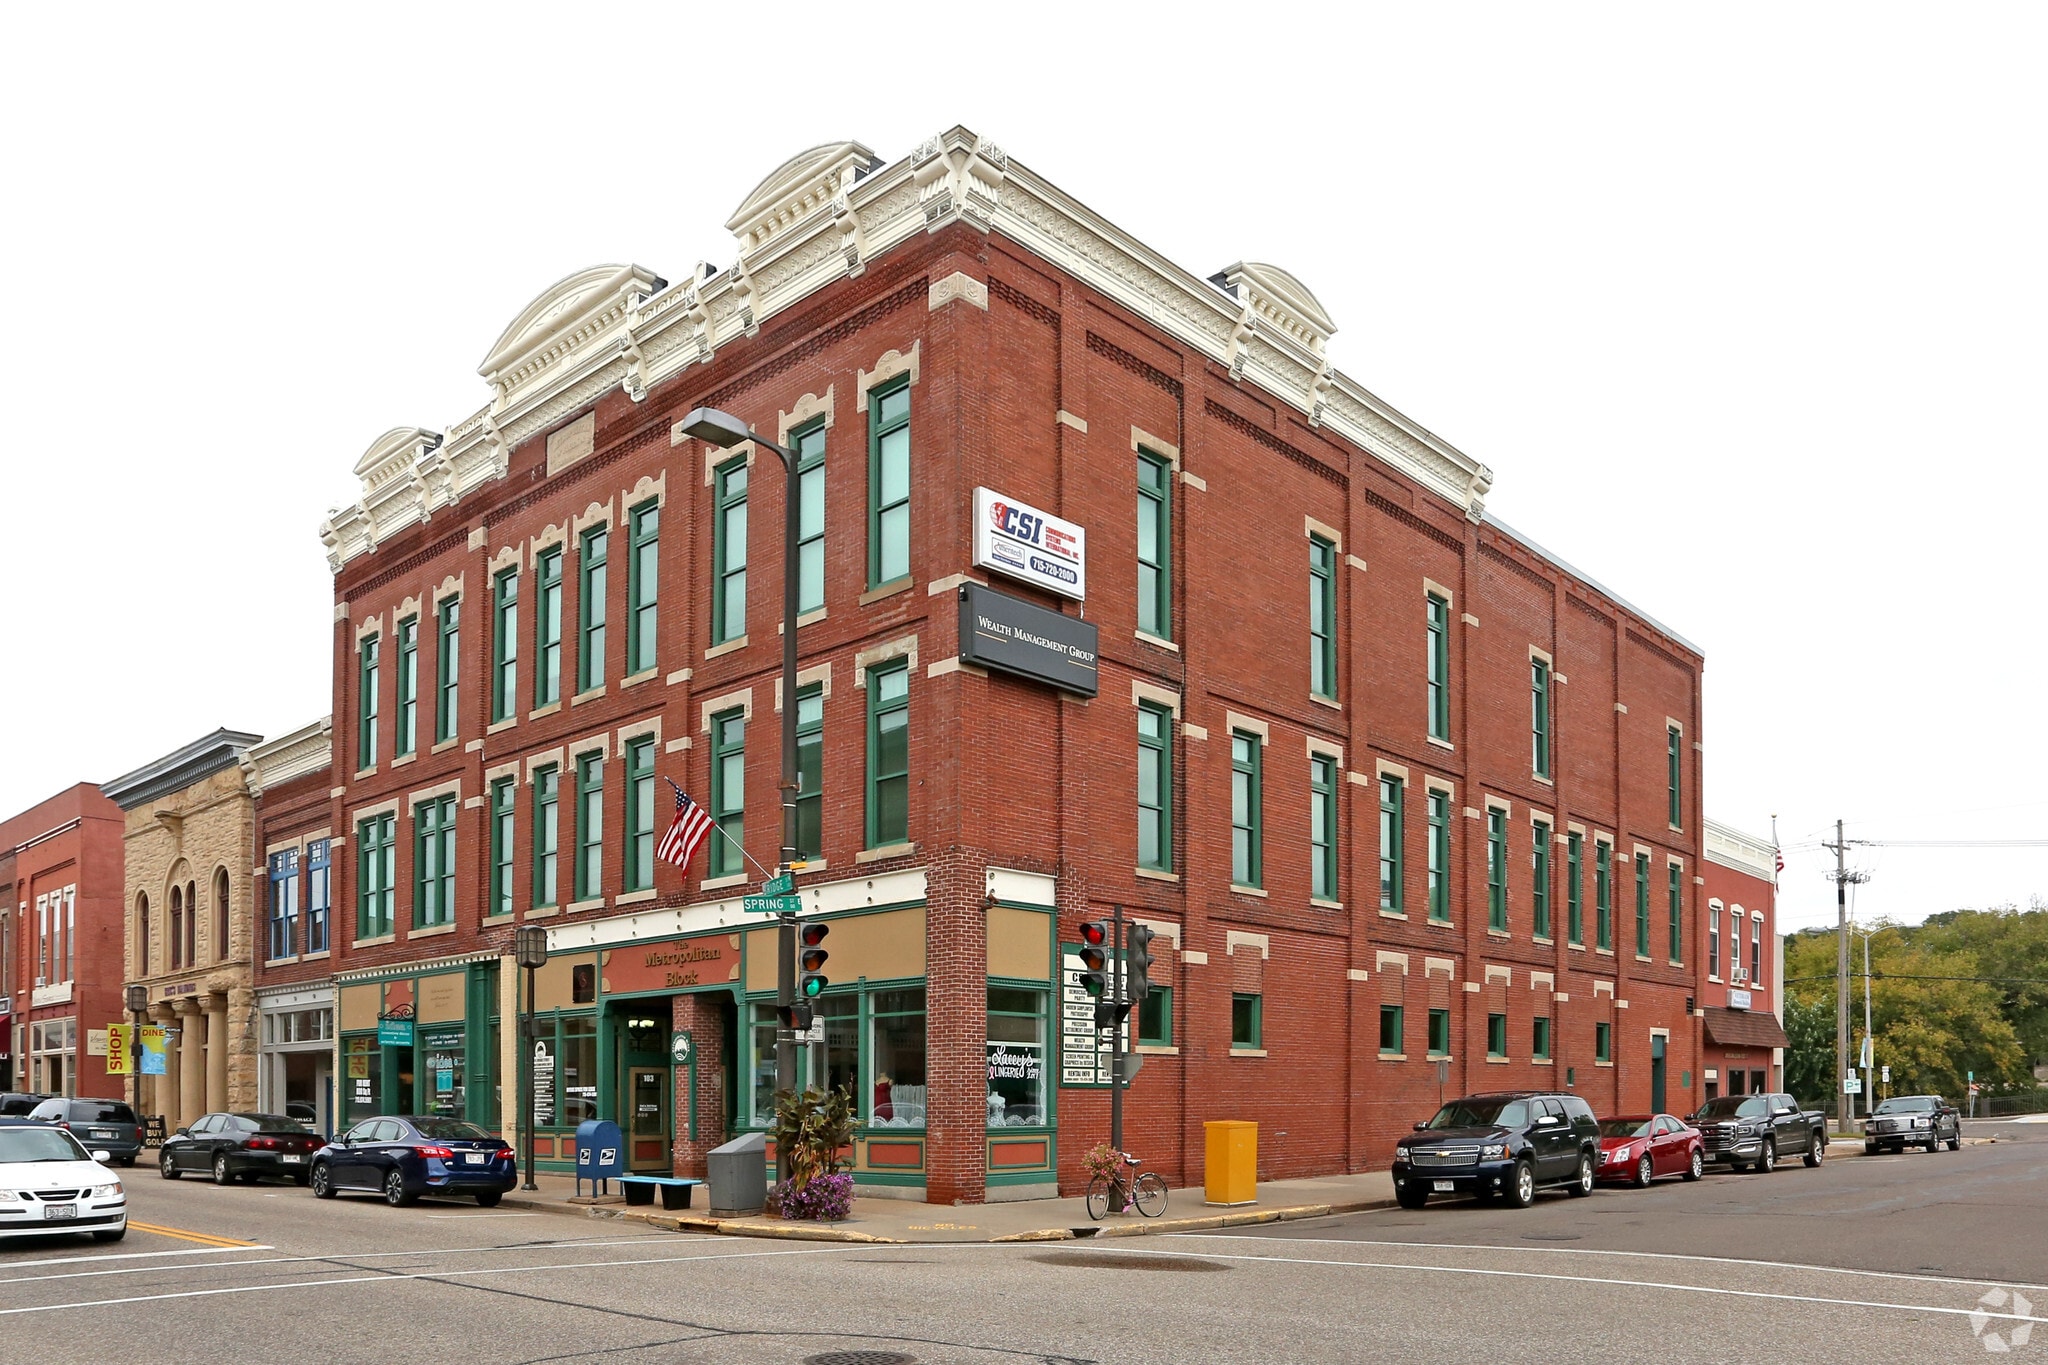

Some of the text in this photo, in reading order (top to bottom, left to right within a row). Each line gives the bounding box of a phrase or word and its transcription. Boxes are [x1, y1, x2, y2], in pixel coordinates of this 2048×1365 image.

[1004, 507, 1043, 544] CSI
[1032, 557, 1075, 583] 715-720-2000
[744, 898, 784, 910] SPRING
[673, 940, 689, 950] The
[645, 946, 721, 968] Metropolitan
[665, 970, 699, 987] Block
[142, 1029, 165, 1037] DINE
[110, 1028, 123, 1070] SHOP
[992, 1044, 1034, 1077] Lacey's
[643, 1074, 654, 1082] 103
[995, 1066, 1020, 1078] LINGERIE
[148, 1120, 160, 1128] WE
[147, 1129, 162, 1137] BUY
